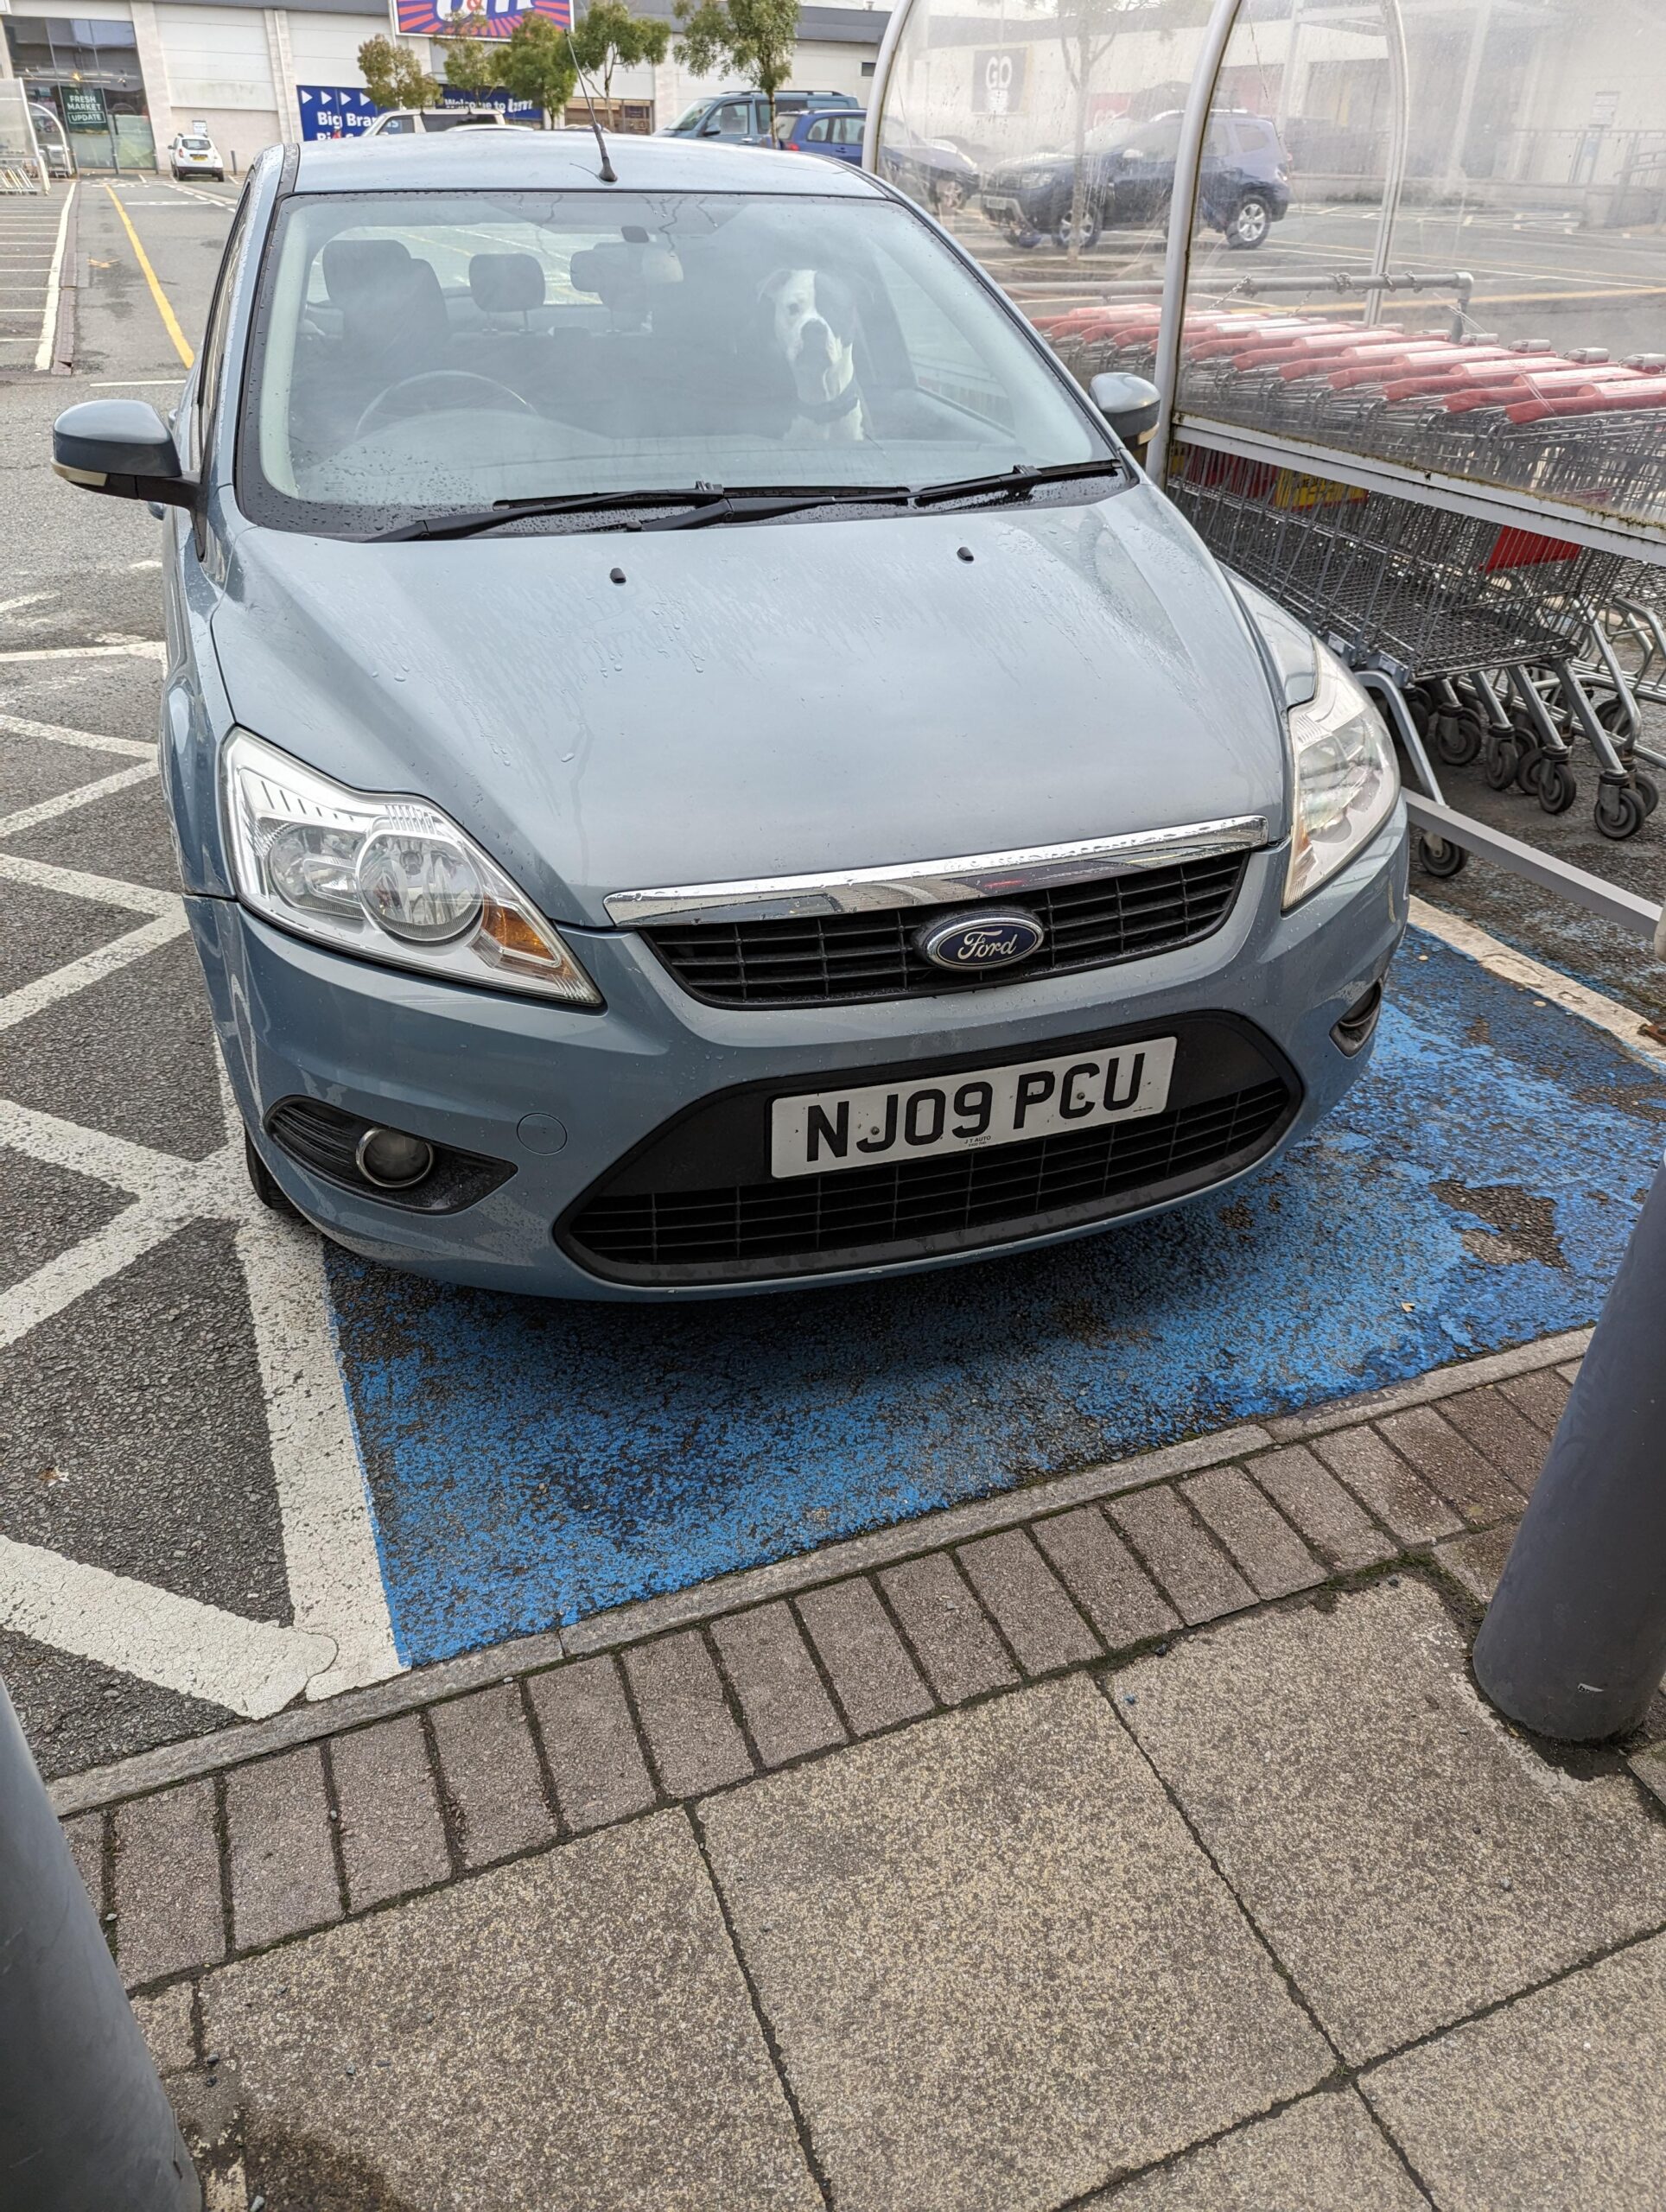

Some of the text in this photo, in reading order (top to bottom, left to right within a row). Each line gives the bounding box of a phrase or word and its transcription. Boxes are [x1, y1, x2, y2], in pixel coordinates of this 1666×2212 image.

[985, 56, 1012, 90] GO
[317, 111, 342, 129] Big
[494, 100, 506, 111] to
[957, 930, 1018, 960] Ford
[806, 1052, 1146, 1162] NJ09 PCU
